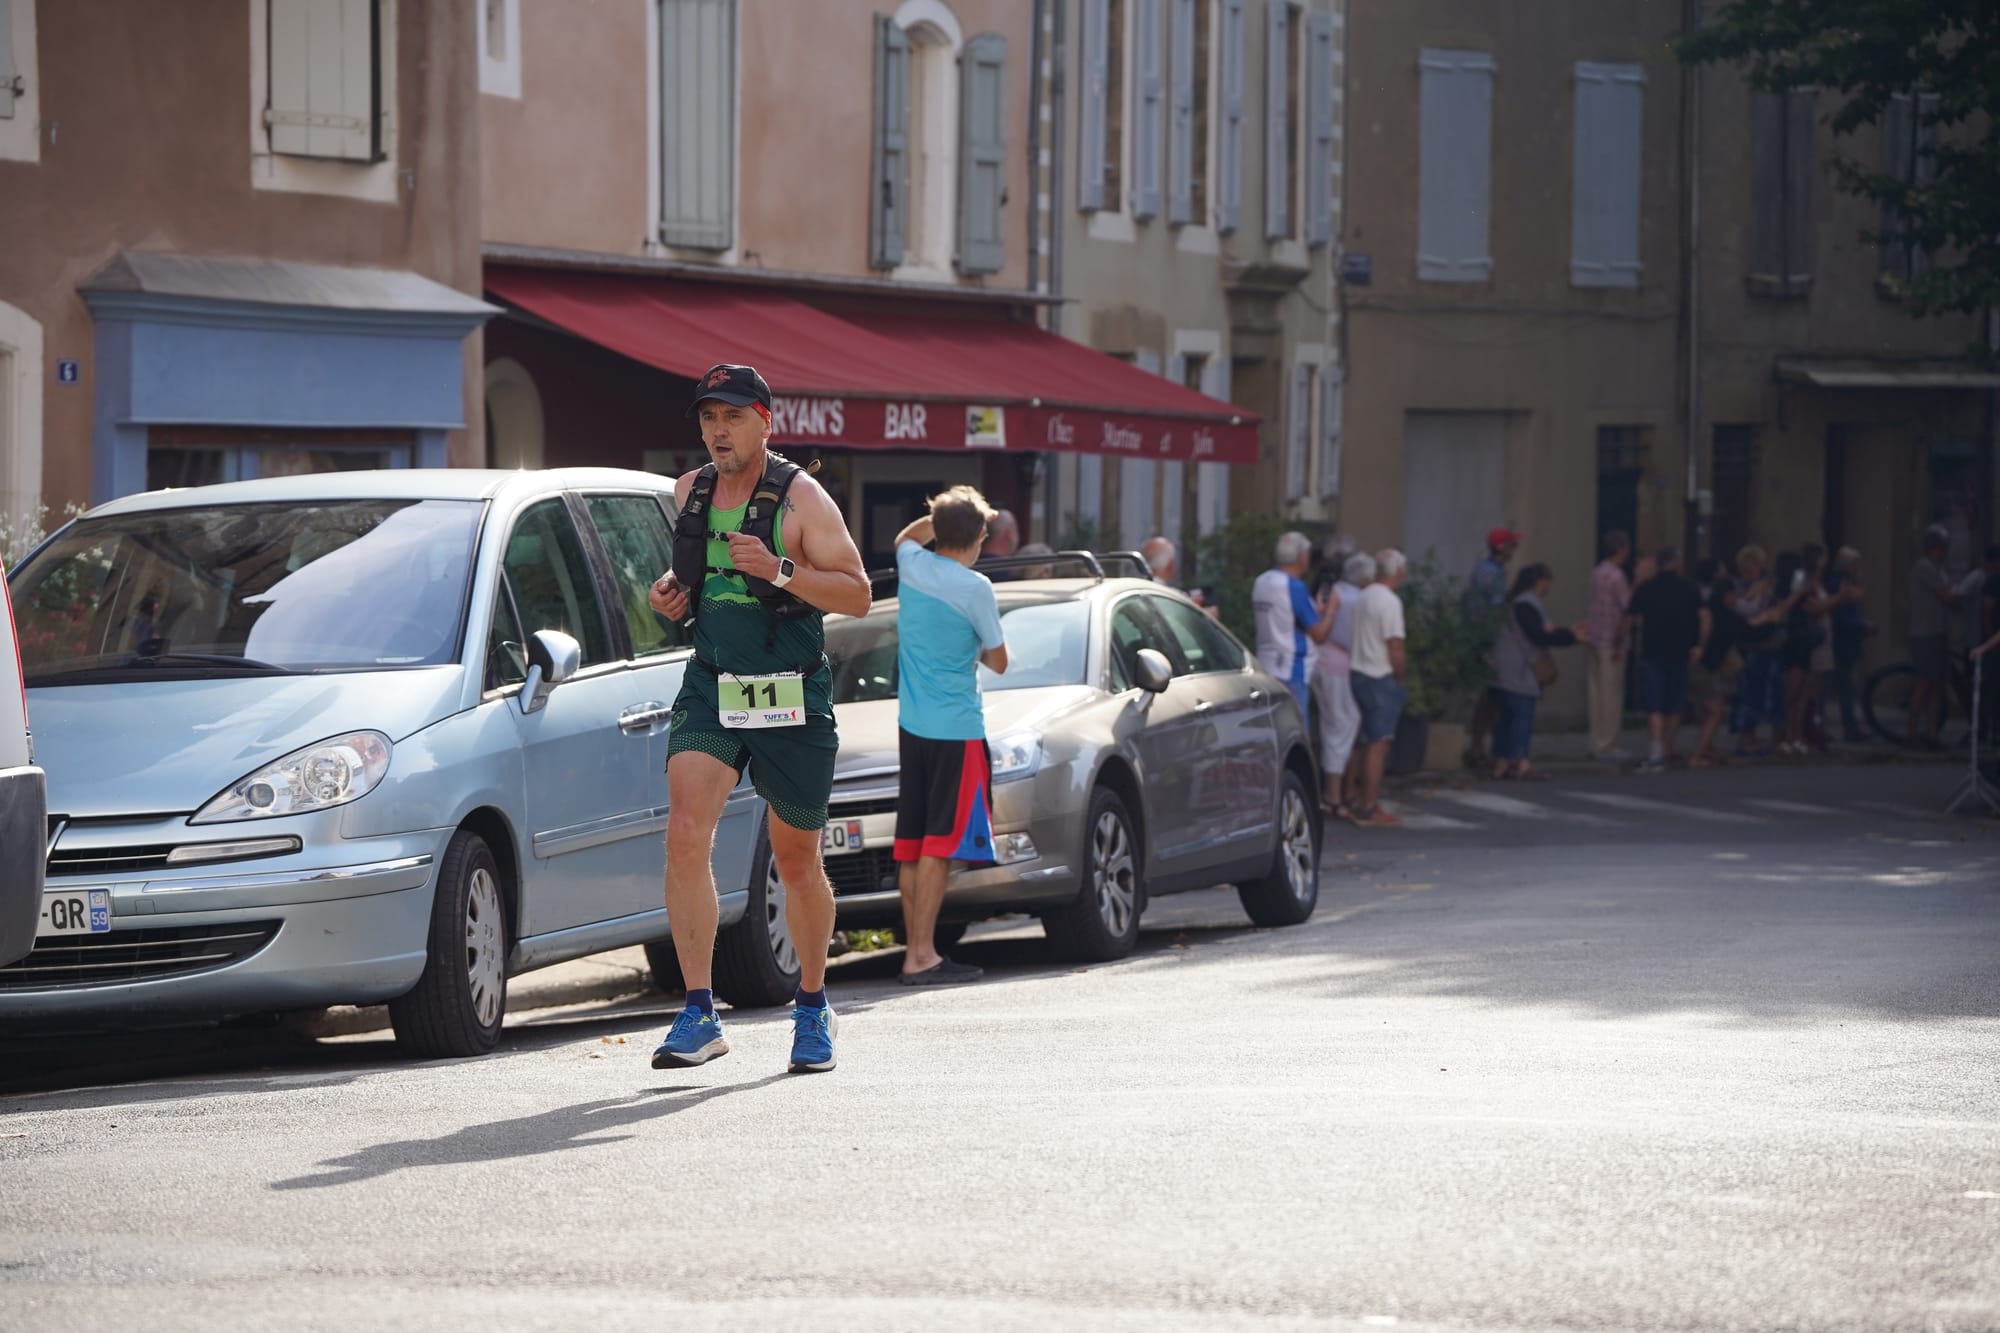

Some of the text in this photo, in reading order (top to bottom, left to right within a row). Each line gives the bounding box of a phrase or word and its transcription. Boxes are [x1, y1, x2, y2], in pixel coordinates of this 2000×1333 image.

[884, 403, 927, 439] BAR
[741, 682, 777, 708] 11
[92, 911, 108, 926] 59
